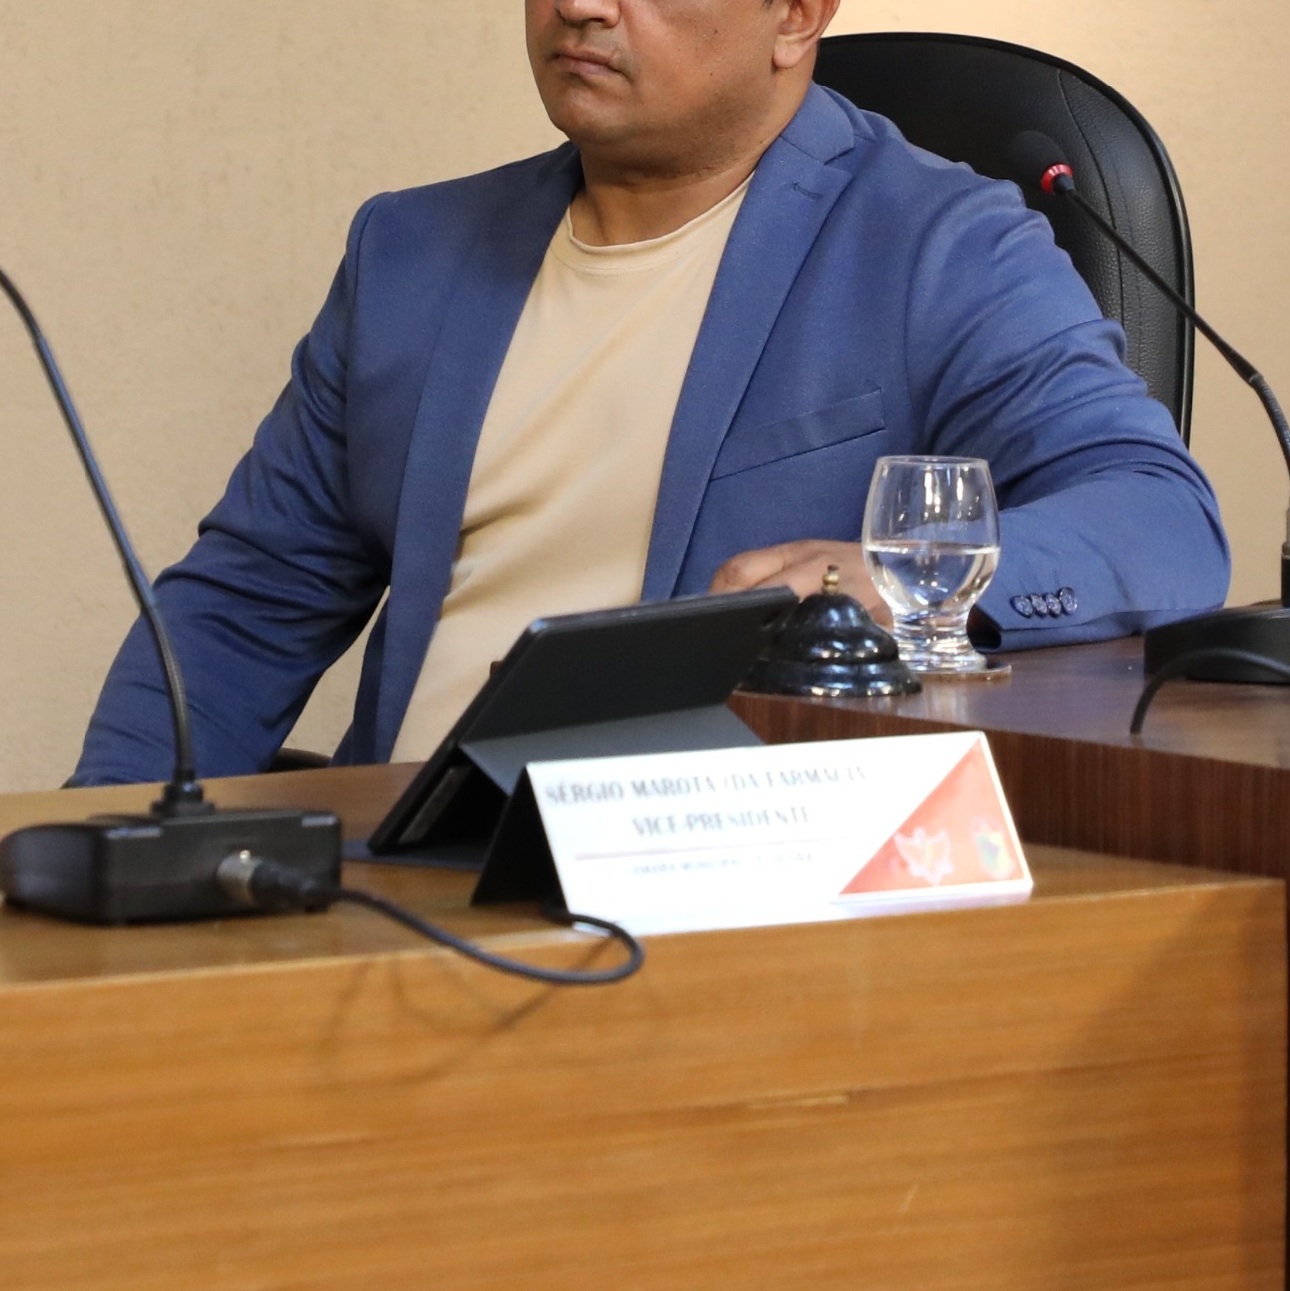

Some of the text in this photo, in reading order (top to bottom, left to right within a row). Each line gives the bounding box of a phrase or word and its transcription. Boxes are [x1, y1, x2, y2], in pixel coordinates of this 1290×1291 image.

[544, 778, 625, 805] SÉRGIO
[631, 775, 716, 799] MAROTA
[631, 806, 808, 838] VICE-PRESIDENTE
